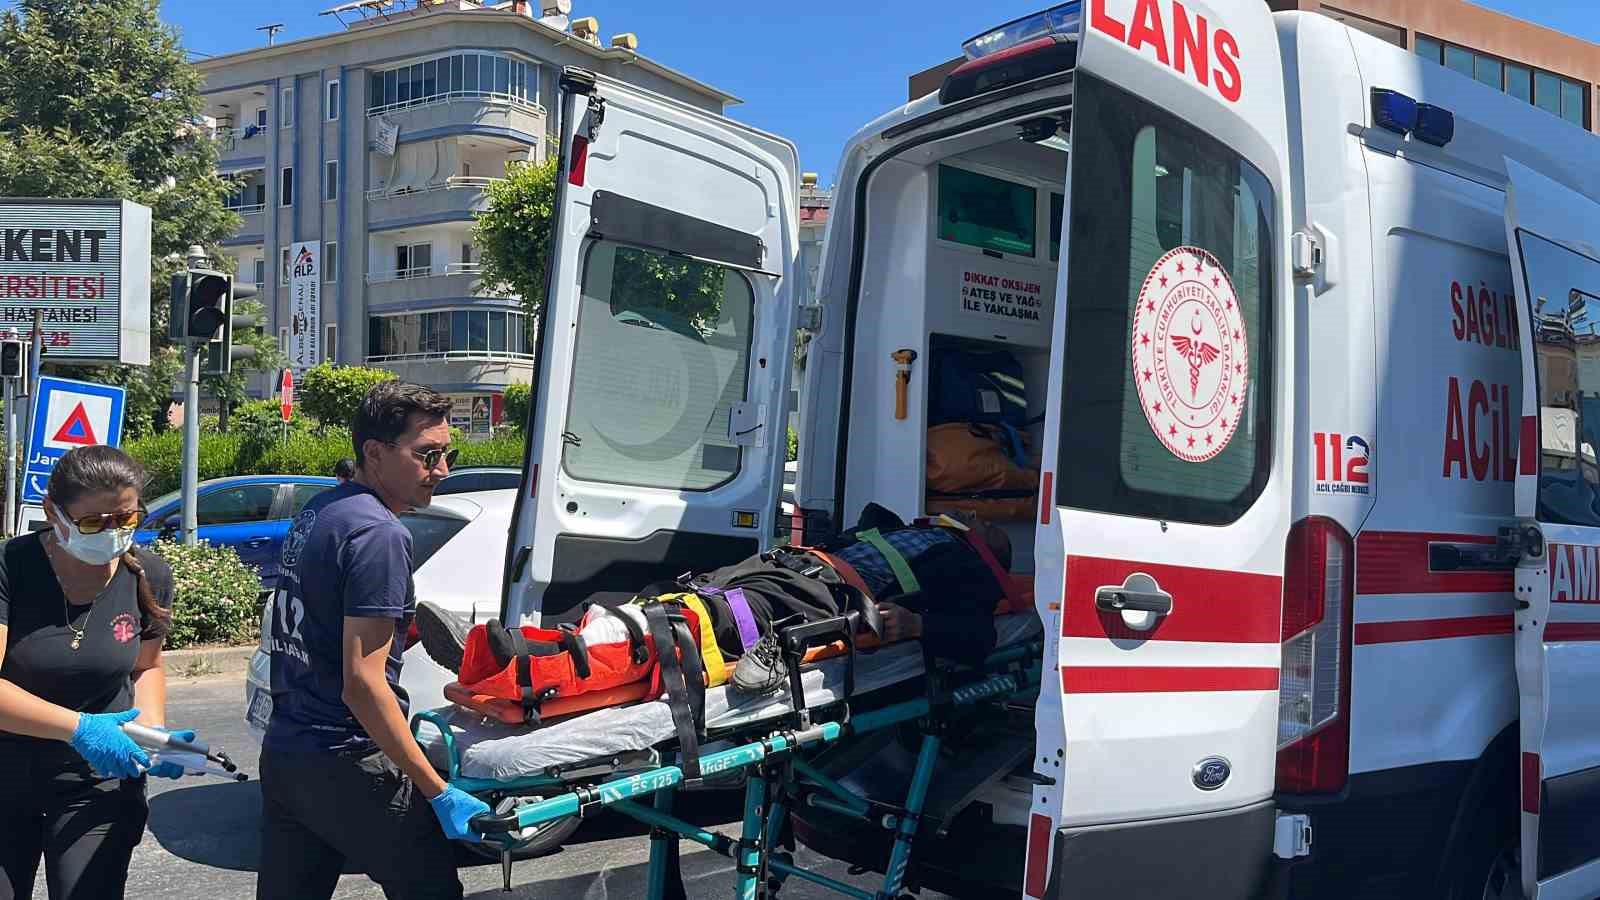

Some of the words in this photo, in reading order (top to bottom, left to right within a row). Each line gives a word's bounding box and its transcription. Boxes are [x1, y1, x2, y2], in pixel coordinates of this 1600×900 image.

[0, 229, 107, 262] KENT
[999, 292, 1012, 303] VE
[1442, 376, 1516, 481] ACİL
[1314, 432, 1369, 483] 112
[1551, 544, 1600, 601] AM
[1203, 765, 1225, 782] Ford
